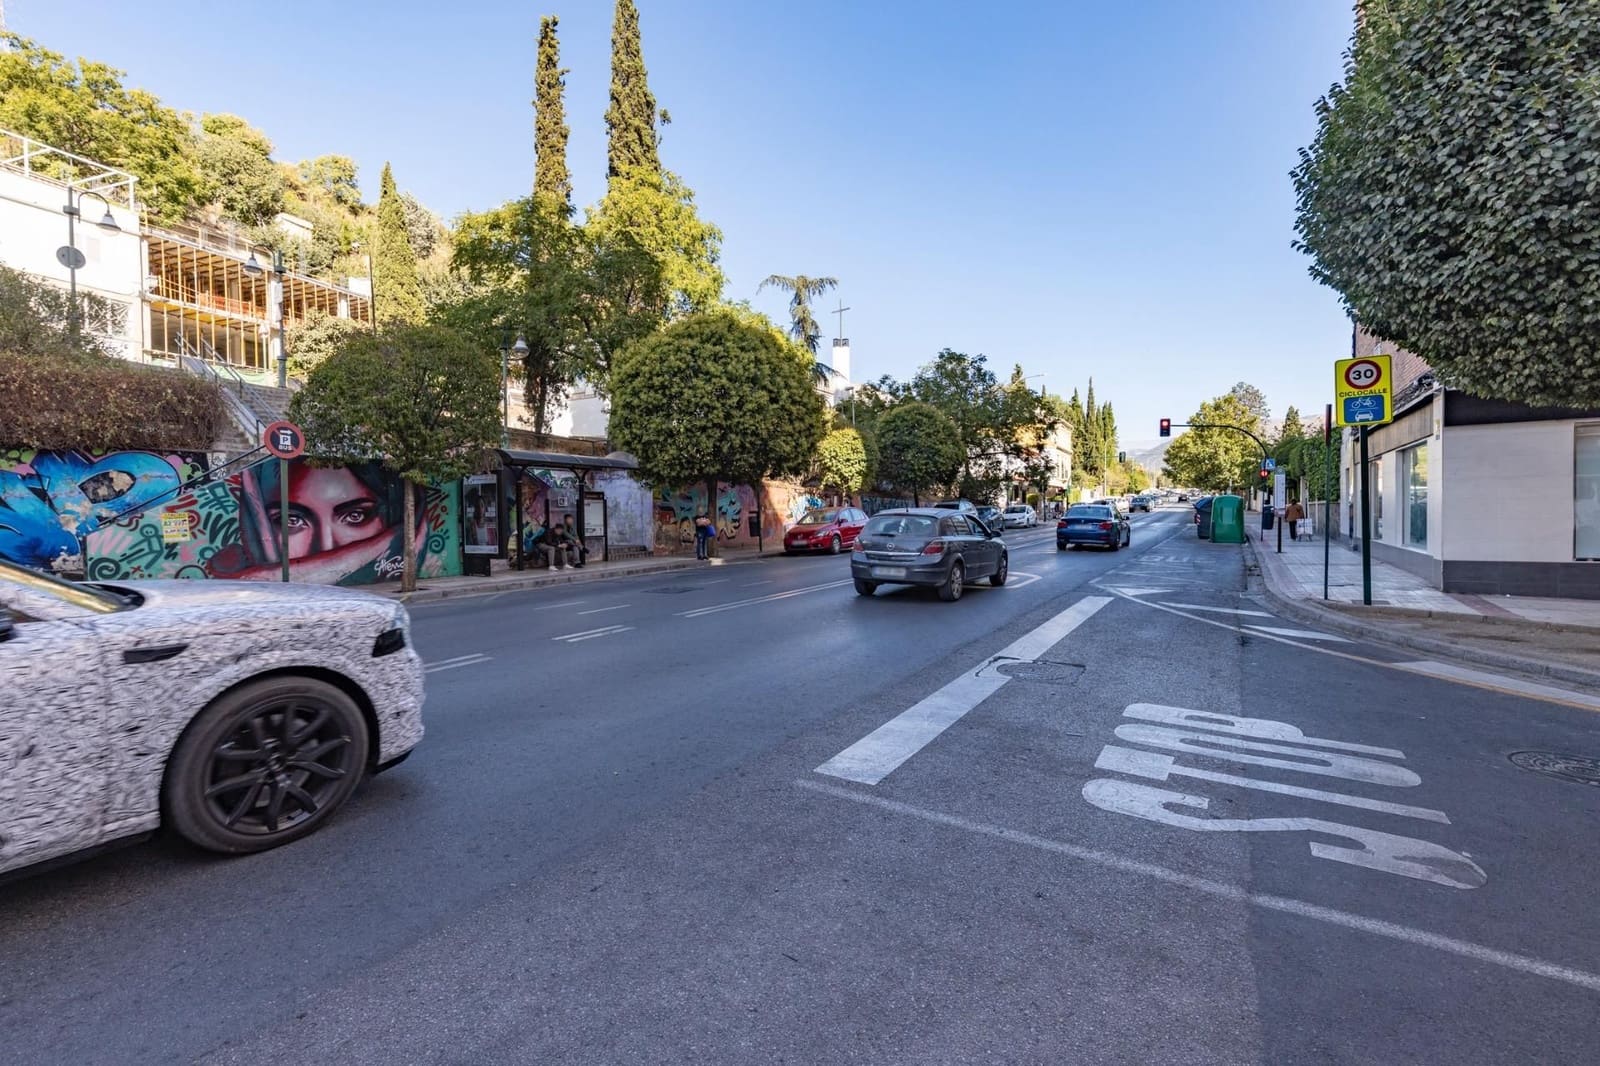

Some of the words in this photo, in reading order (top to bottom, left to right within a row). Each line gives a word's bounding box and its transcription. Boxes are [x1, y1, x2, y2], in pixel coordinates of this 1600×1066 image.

[1352, 369, 1374, 380] 30
[1339, 388, 1388, 397] CICLOCALLE
[1082, 702, 1488, 889] STOP
